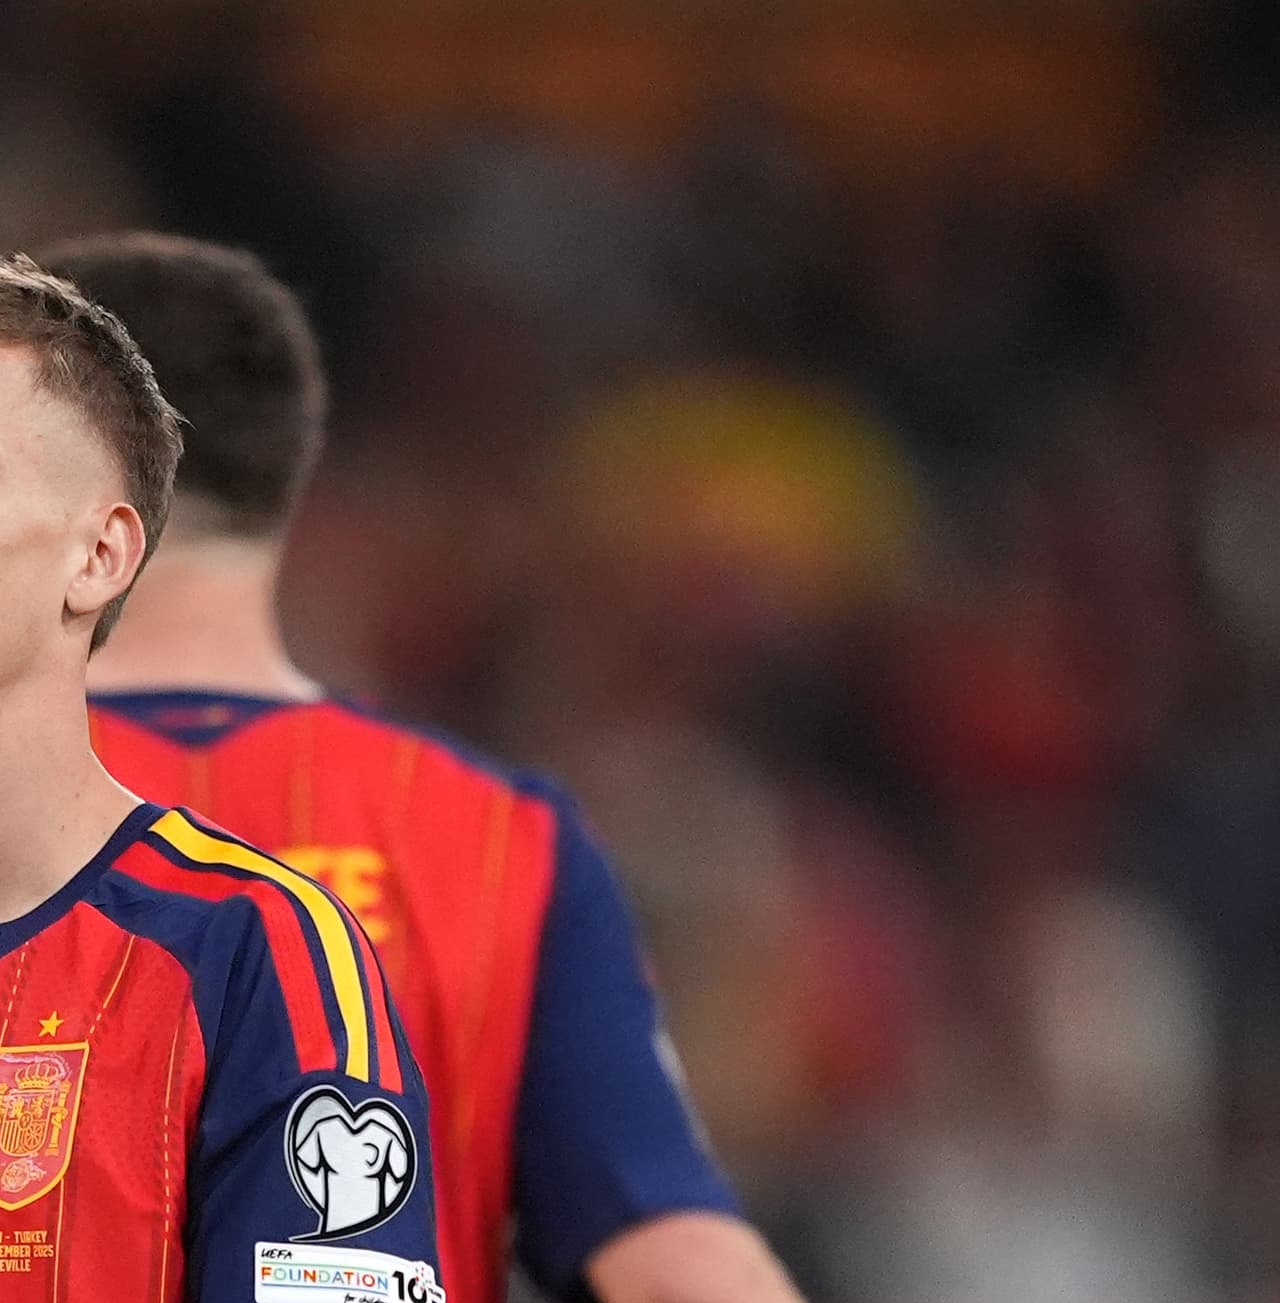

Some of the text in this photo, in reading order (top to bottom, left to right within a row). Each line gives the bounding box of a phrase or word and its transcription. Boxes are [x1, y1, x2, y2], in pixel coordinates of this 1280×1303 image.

[13, 1230, 48, 1244] TURKEY
[33, 1244, 54, 1258] 2025
[261, 1248, 293, 1260] UEFA
[260, 1266, 389, 1291] FOUNDATION
